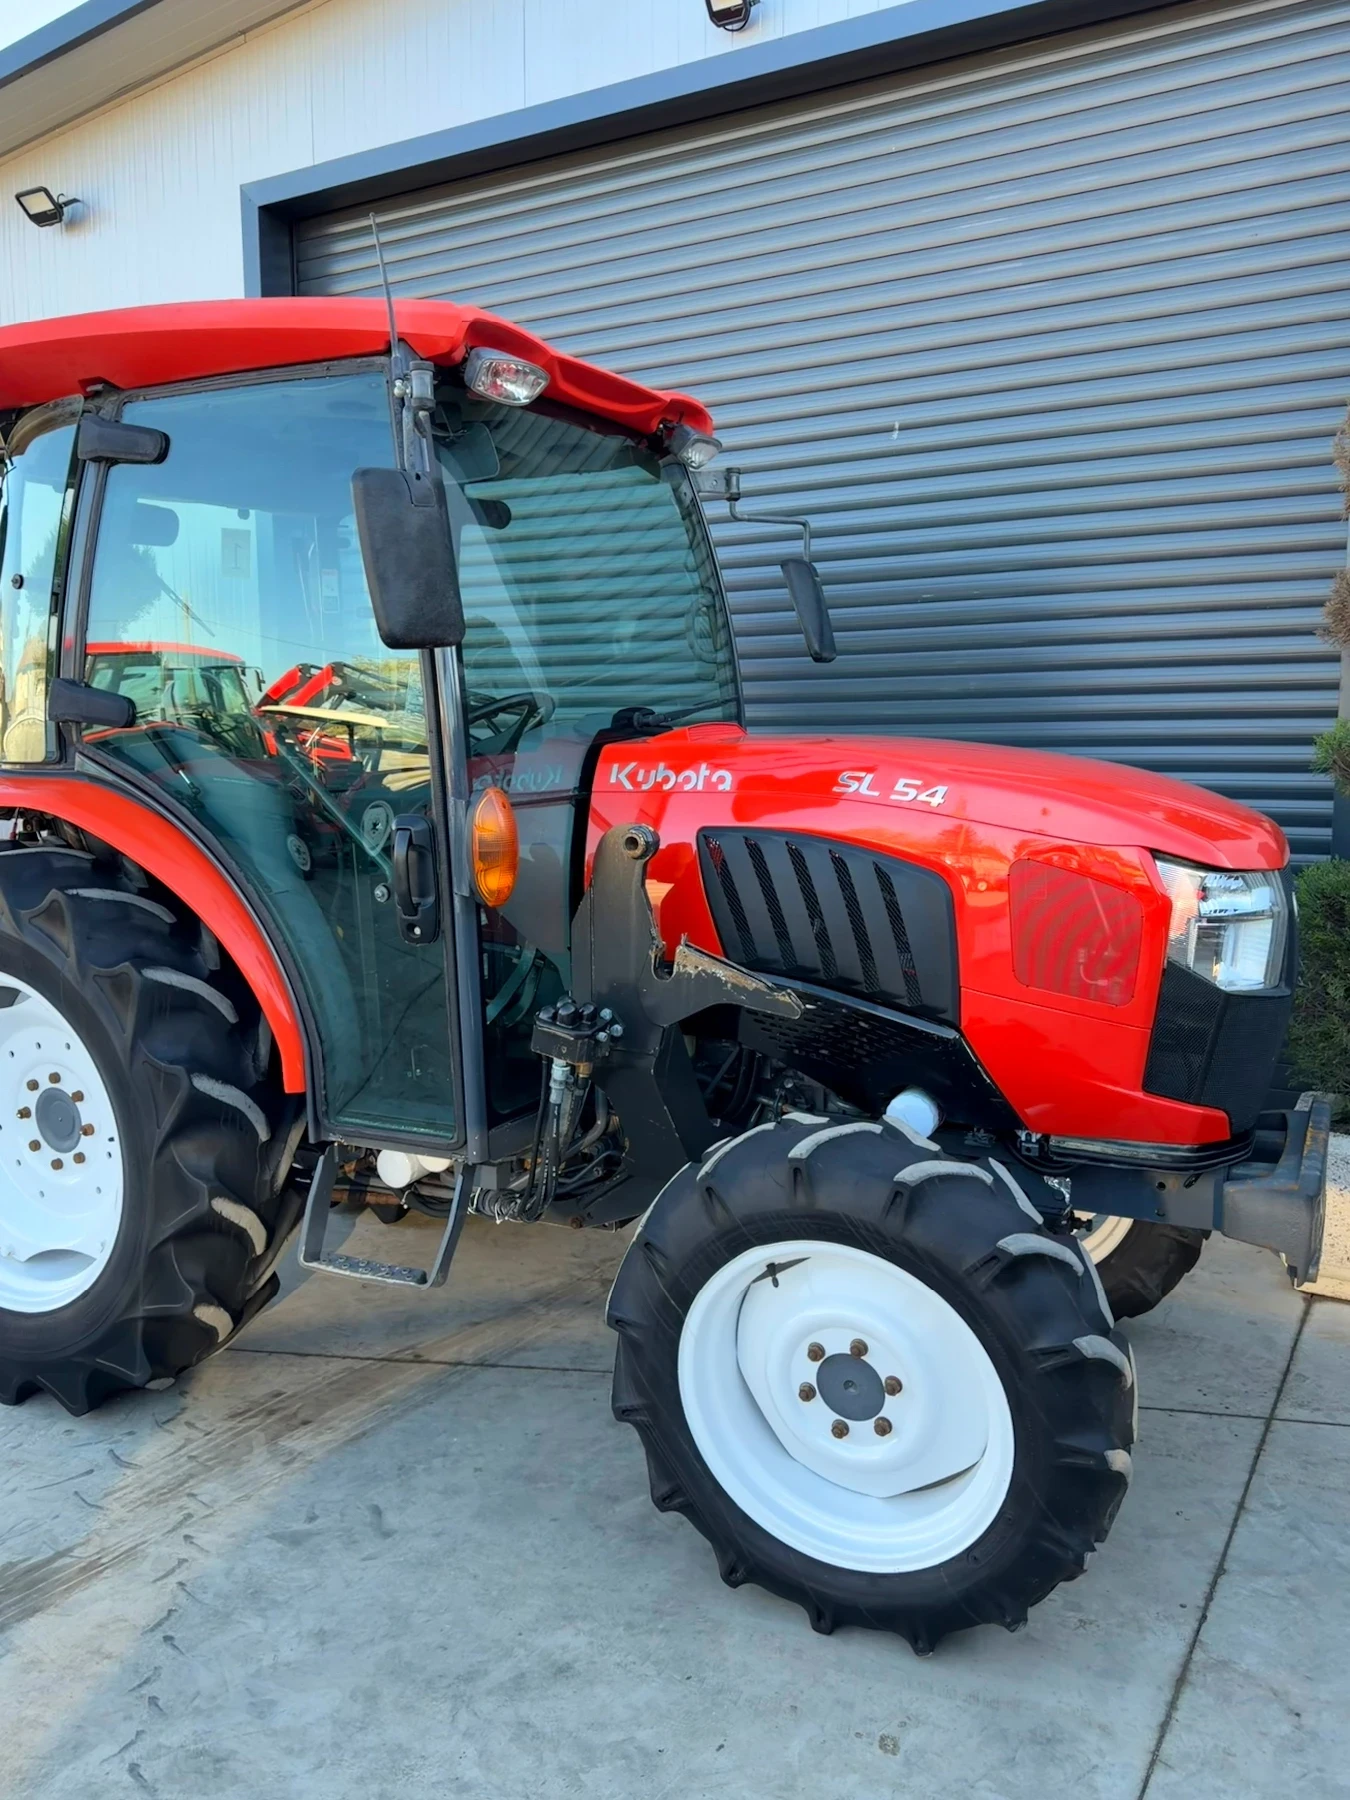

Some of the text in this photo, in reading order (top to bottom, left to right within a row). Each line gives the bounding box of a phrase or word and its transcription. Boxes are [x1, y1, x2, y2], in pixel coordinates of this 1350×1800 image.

[609, 762, 732, 790] Kubota
[832, 771, 948, 808] SL 54
